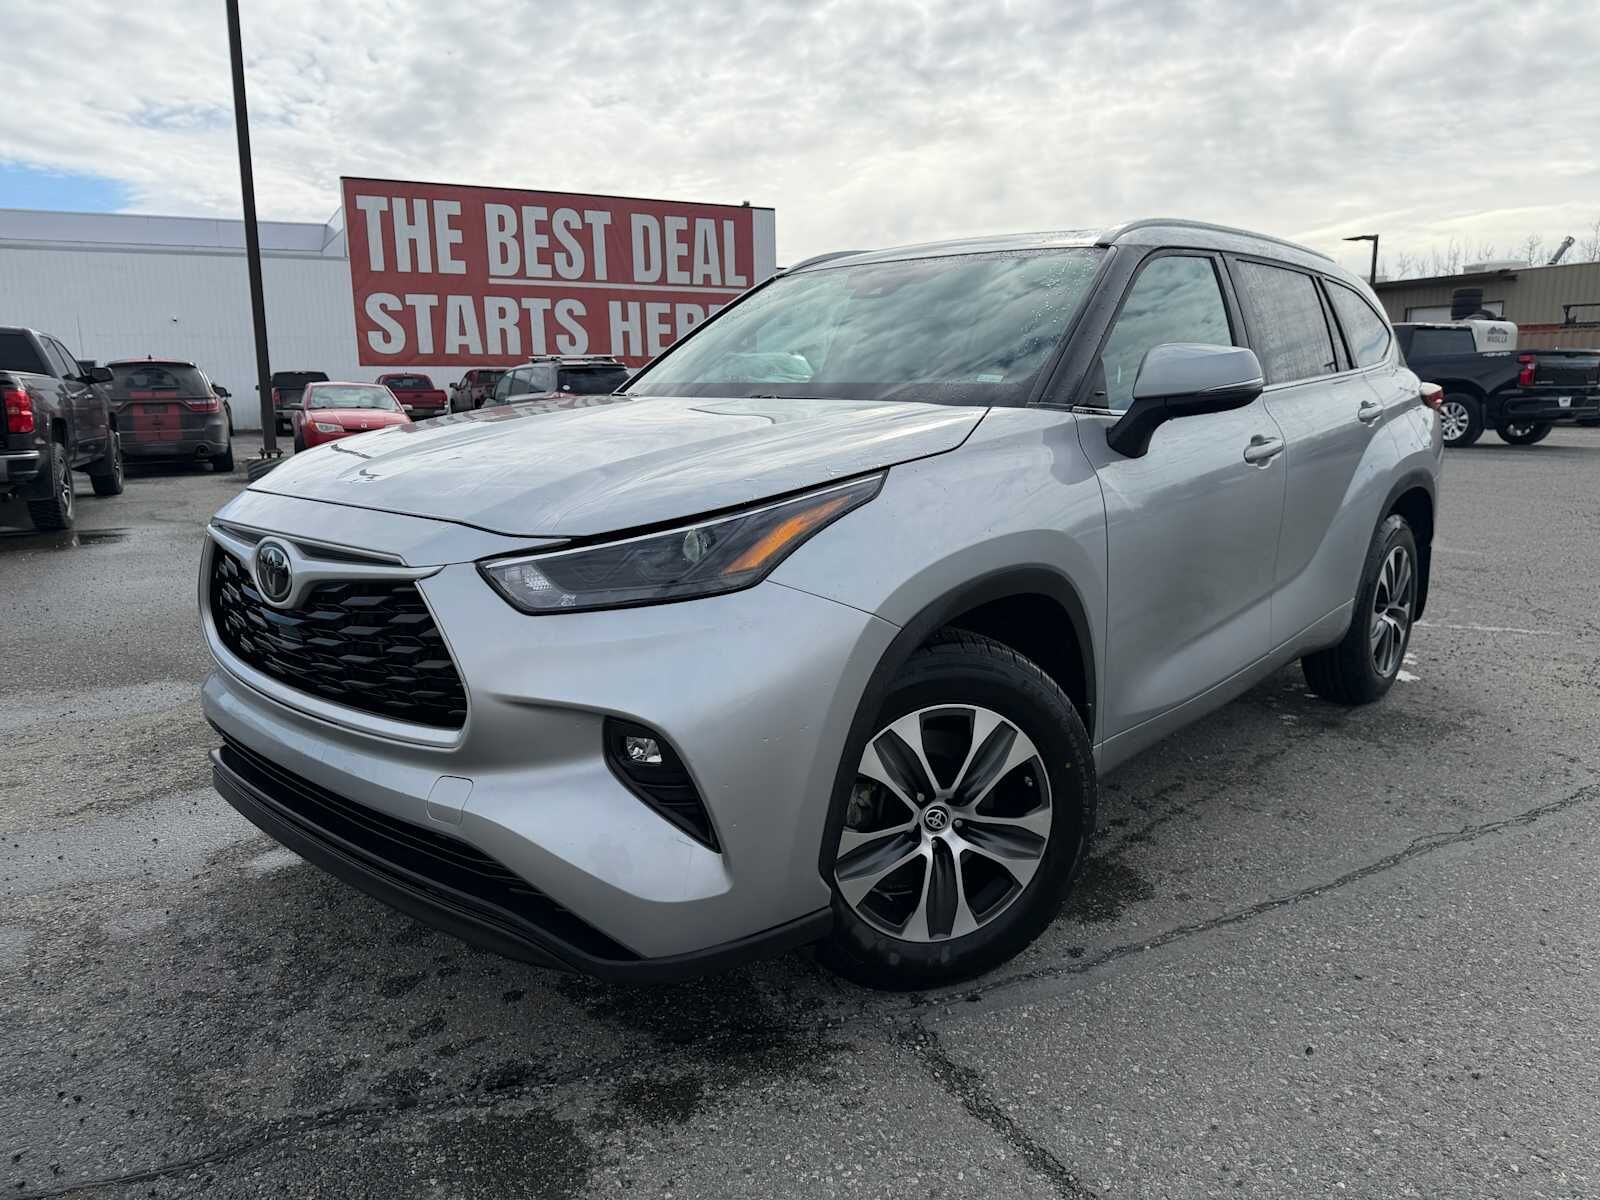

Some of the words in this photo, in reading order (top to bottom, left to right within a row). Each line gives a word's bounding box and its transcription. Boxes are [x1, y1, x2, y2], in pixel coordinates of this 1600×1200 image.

[355, 194, 467, 275] THE
[484, 203, 612, 281] BEST
[630, 213, 747, 287] DEAL
[365, 292, 590, 356] STARTS
[608, 301, 726, 357] HER
